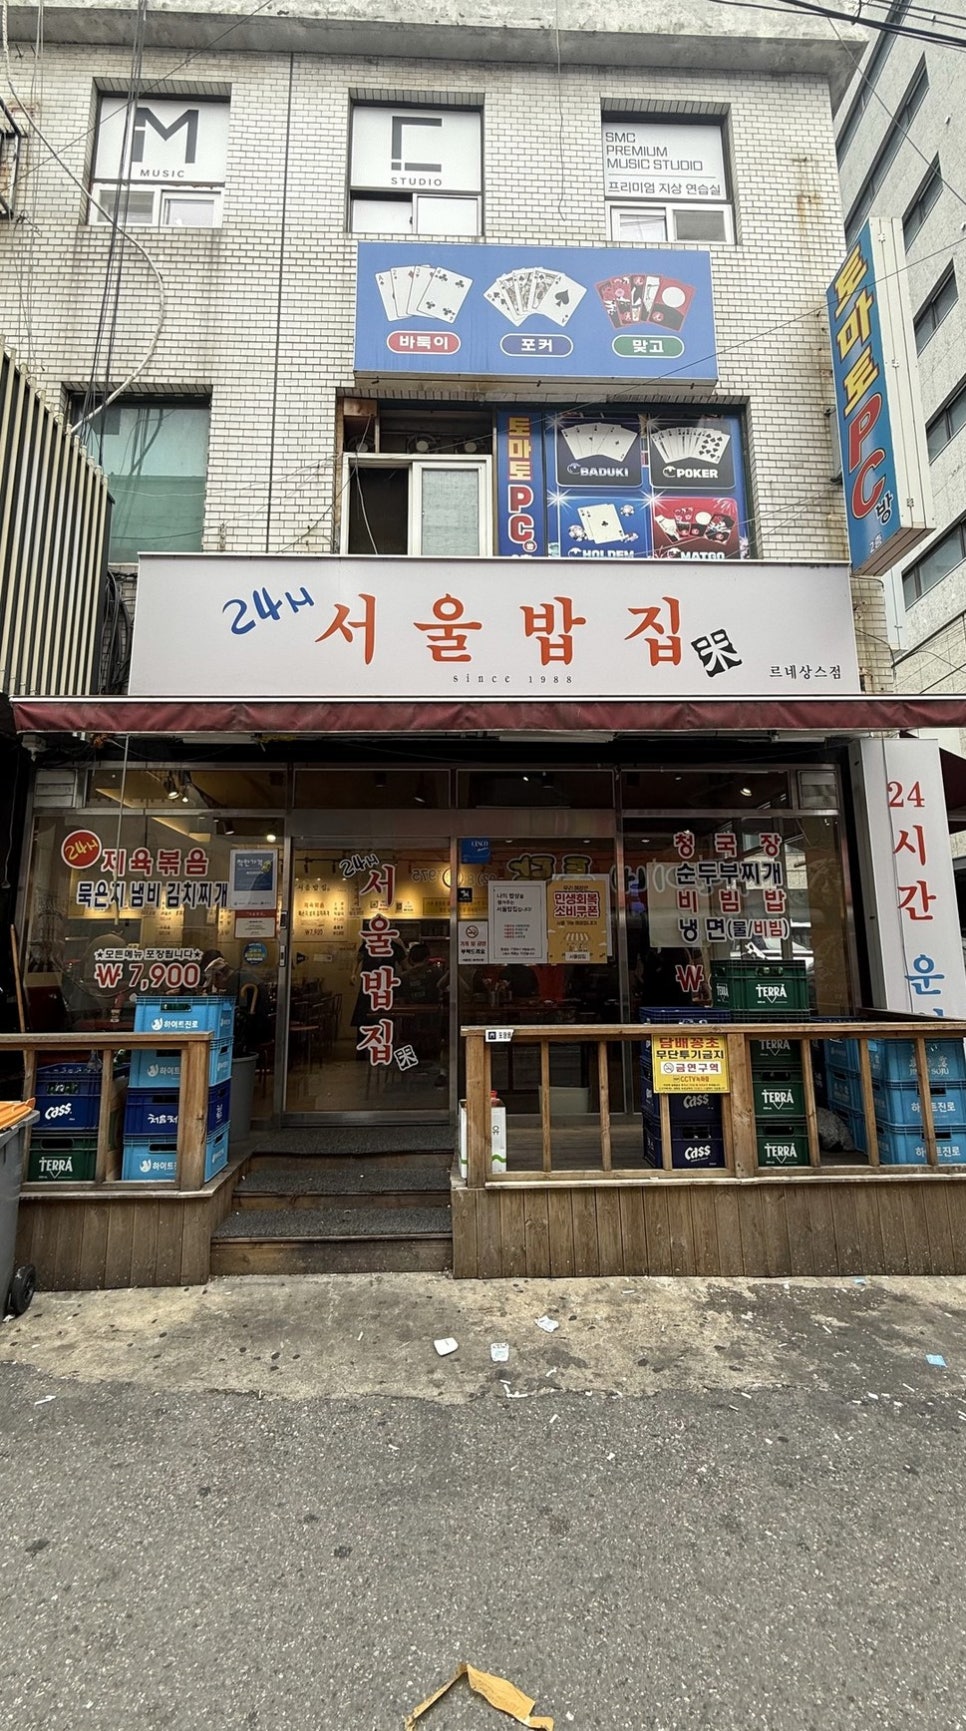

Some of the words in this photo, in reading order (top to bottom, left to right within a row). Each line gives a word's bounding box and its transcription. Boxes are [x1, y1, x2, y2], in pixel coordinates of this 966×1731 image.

[605, 132, 636, 143] SMC
[606, 145, 668, 157] PREMIUM
[607, 158, 651, 170] MUSIC
[653, 160, 703, 172] STUDIO
[140, 169, 185, 178] MUSIC
[391, 176, 443, 187] STUDIO
[608, 181, 655, 194] 프리미엄
[658, 182, 682, 195] 지상
[686, 183, 721, 196] 연습실
[834, 244, 880, 416] 토마토
[399, 335, 449, 350] 바둑이
[521, 338, 553, 352] 포커
[632, 339, 664, 353] 맞고
[508, 415, 532, 481] 토마토
[580, 467, 629, 477] BADUKI
[676, 468, 719, 479] POKER
[222, 586, 315, 635] 24H
[314, 593, 682, 667] 서울밥집
[453, 673, 511, 683] since
[528, 675, 572, 684] 1988
[769, 664, 841, 680] 르네상스점
[64, 839, 99, 861] 24H
[674, 832, 780, 859] 청국장
[101, 848, 208, 876] 제육볶음
[340, 854, 379, 878] 24H
[676, 861, 783, 886] 순두부찌개
[77, 880, 126, 909] 묵은지
[131, 881, 161, 909] 냄비
[166, 881, 228, 909] 김치찌개
[555, 893, 598, 905] 민생회복
[677, 889, 786, 913] 비빔밥
[555, 905, 598, 917] 소비쿠폰
[357, 864, 401, 1066] 서울밥집
[756, 984, 787, 998] TERRA
[904, 953, 945, 1016] 운
[163, 1019, 198, 1029] 하이트진로
[659, 1037, 720, 1049] 담배꽁초
[759, 1039, 791, 1050] TERRA
[656, 1050, 724, 1060] 무단투기금지
[676, 1063, 718, 1073] 금연구역
[762, 1089, 794, 1104] TERRA
[911, 1101, 956, 1113] 하트진로
[764, 1143, 797, 1157] TERRA
[915, 1146, 961, 1157] 하트진로
[39, 1156, 73, 1173] TERRA
